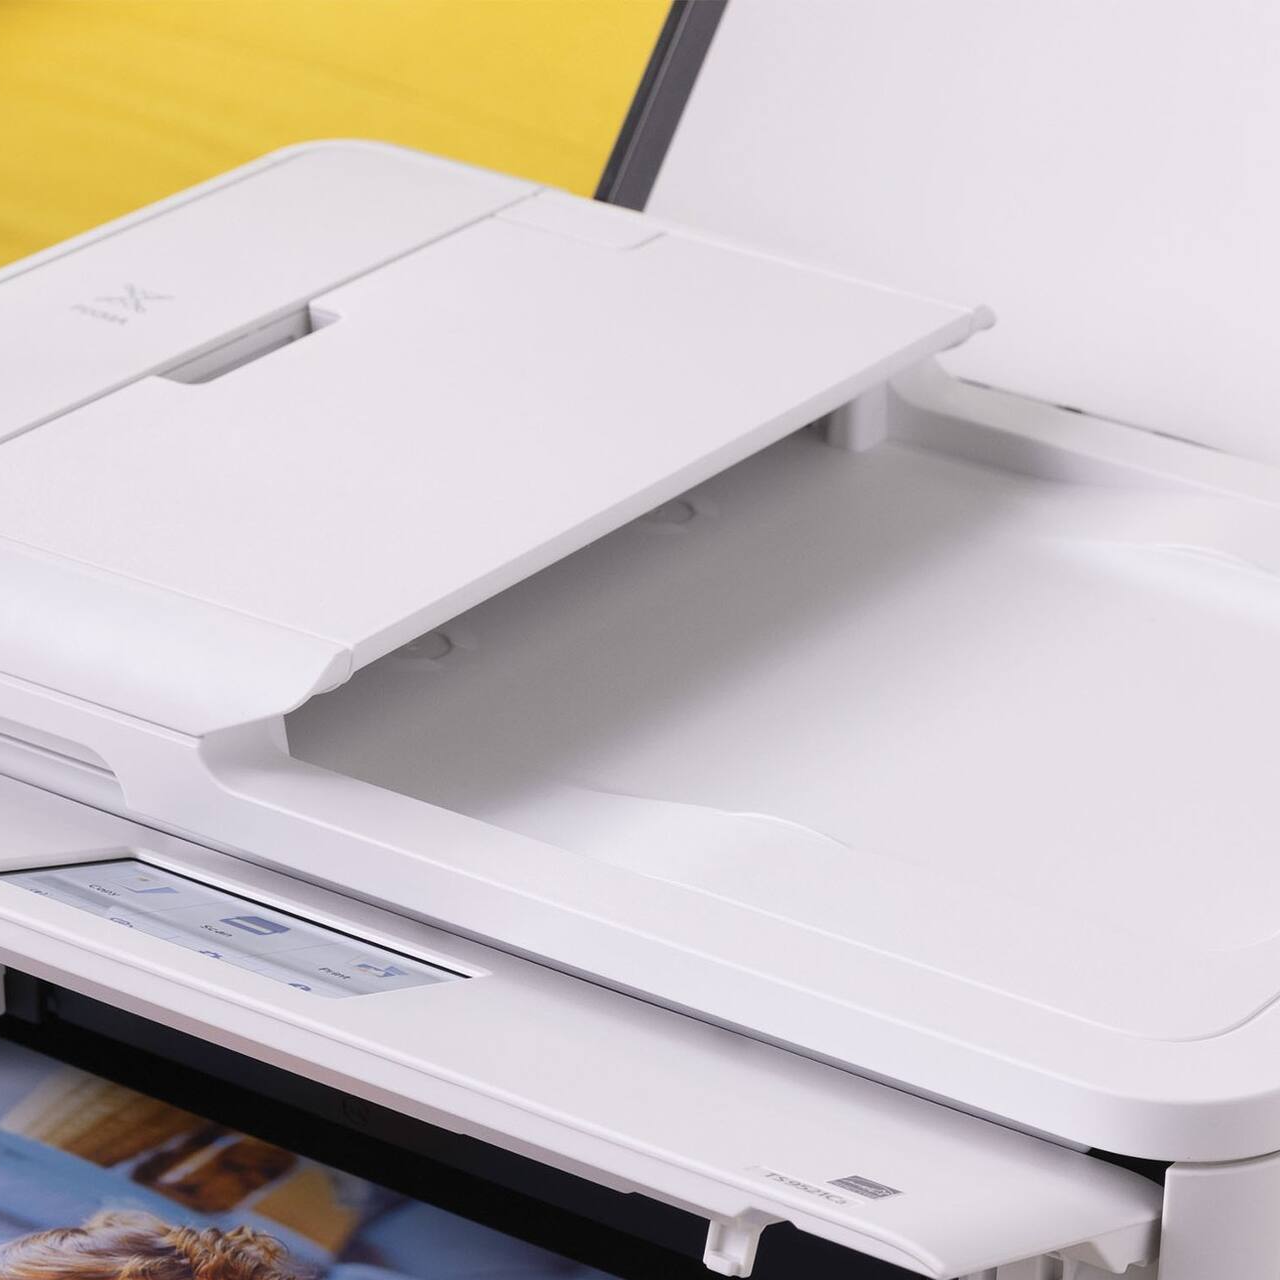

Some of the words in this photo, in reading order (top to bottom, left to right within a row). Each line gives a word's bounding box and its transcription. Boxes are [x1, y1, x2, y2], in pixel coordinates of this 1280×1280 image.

[88, 883, 120, 897] Copy
[200, 923, 233, 938] Scan
[318, 966, 352, 981] Print
